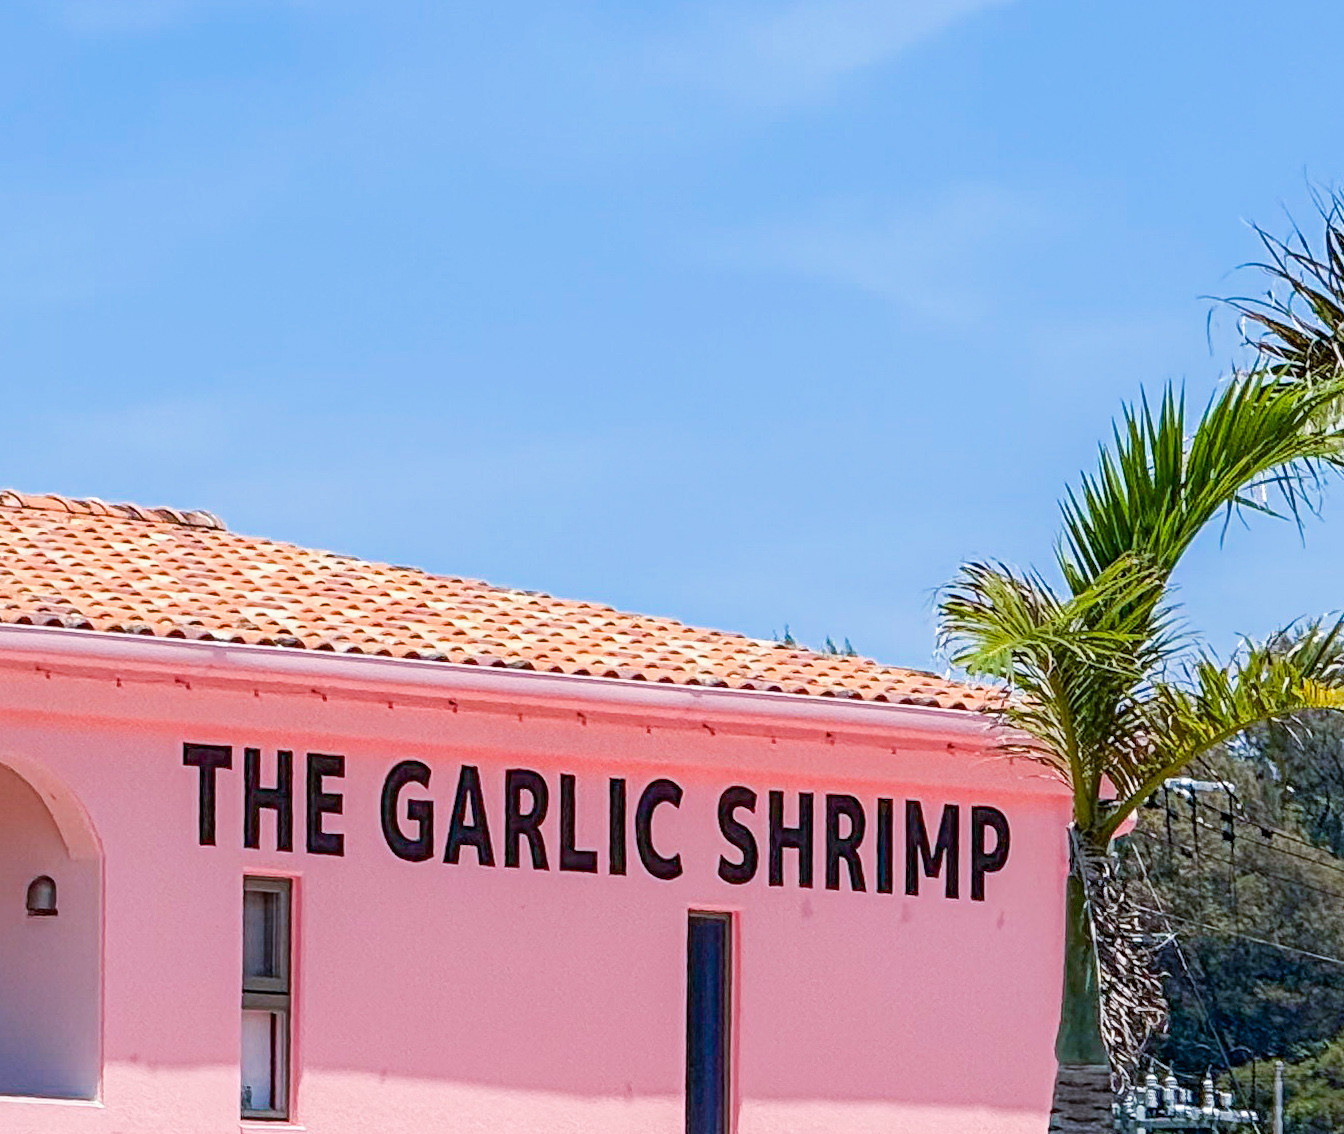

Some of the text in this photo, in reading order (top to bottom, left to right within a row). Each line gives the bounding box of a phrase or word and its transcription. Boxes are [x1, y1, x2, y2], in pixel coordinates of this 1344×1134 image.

[182, 741, 1012, 903] THE GARLIC SHRIMP
